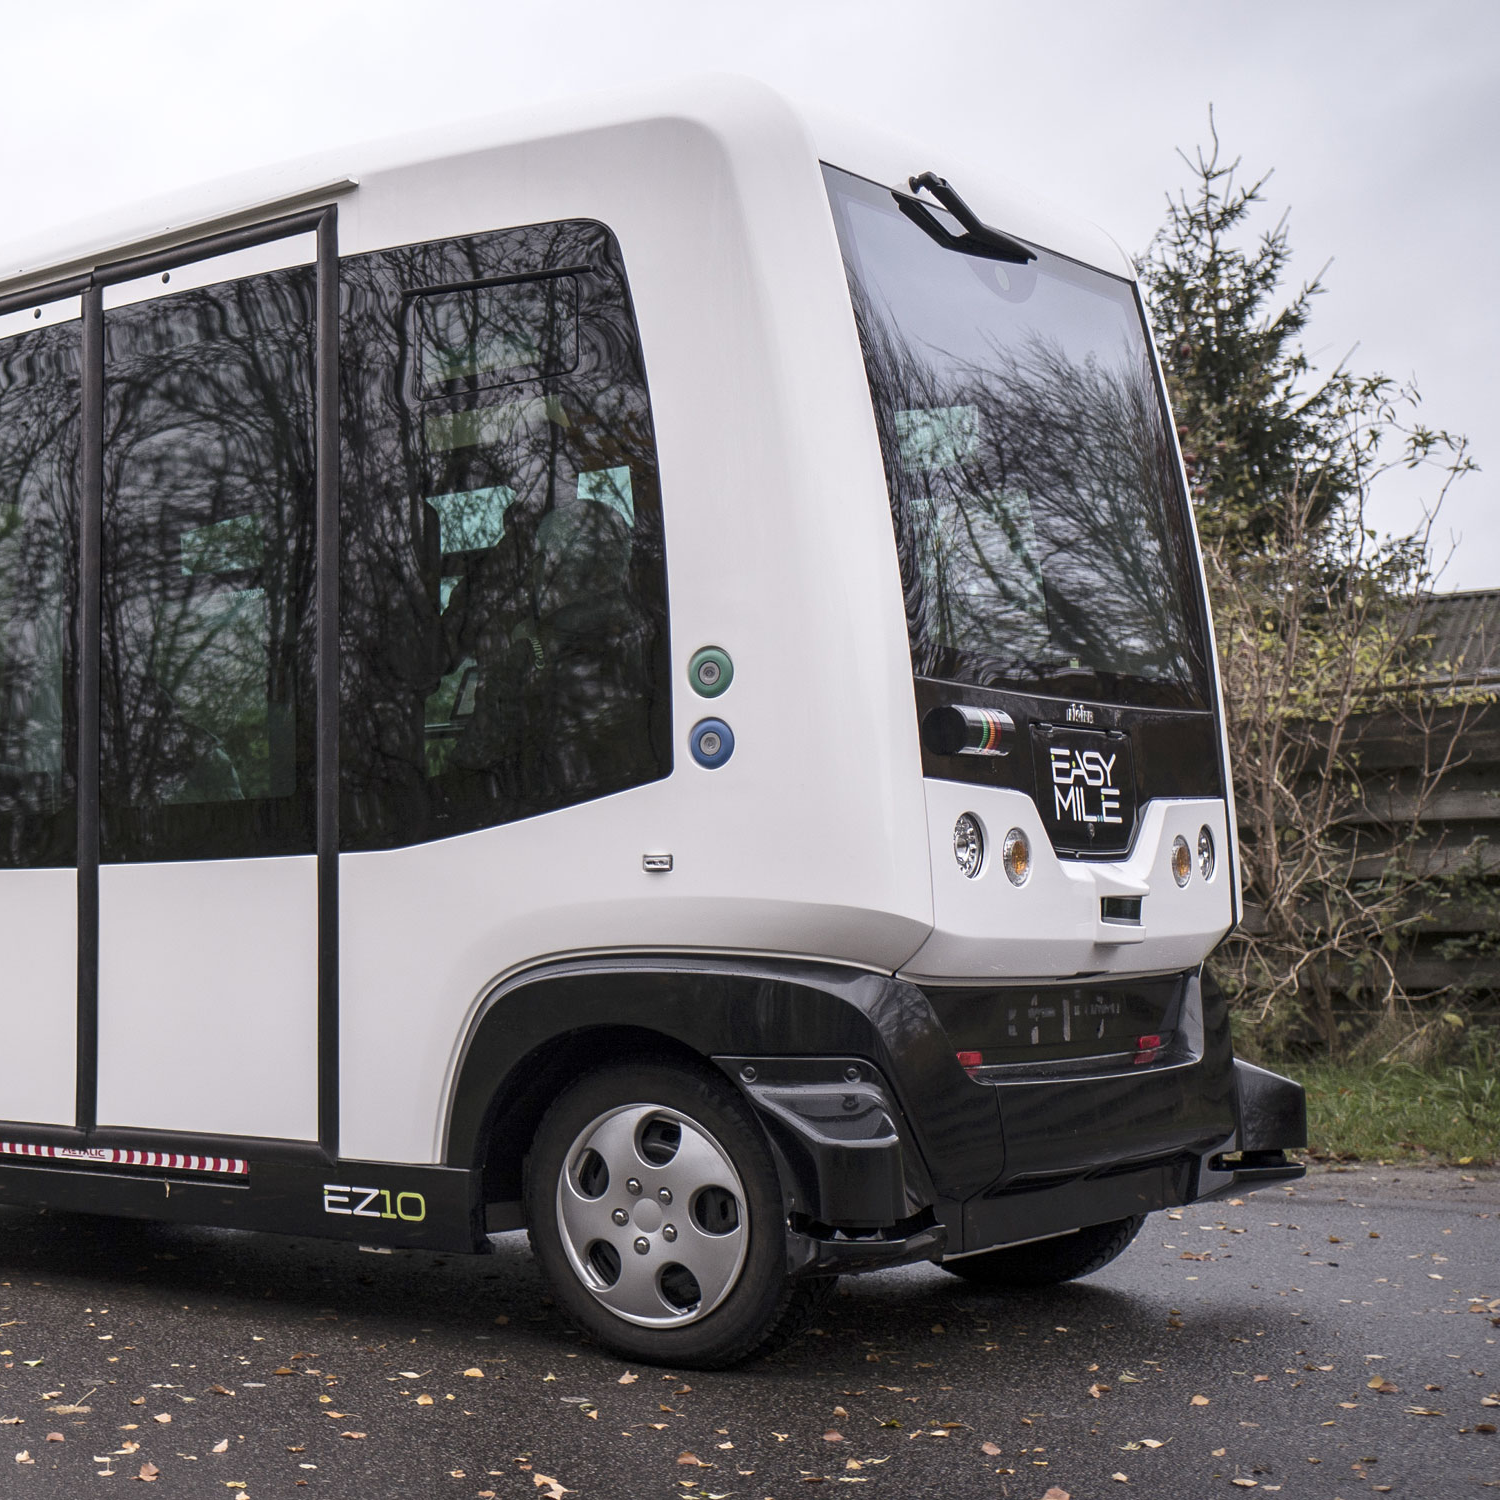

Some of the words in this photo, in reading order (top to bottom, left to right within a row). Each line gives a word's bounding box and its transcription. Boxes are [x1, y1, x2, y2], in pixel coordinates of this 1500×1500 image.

[1049, 748, 1116, 786] EASY
[1054, 785, 1122, 823] MILE
[323, 1184, 426, 1222] EZ10
